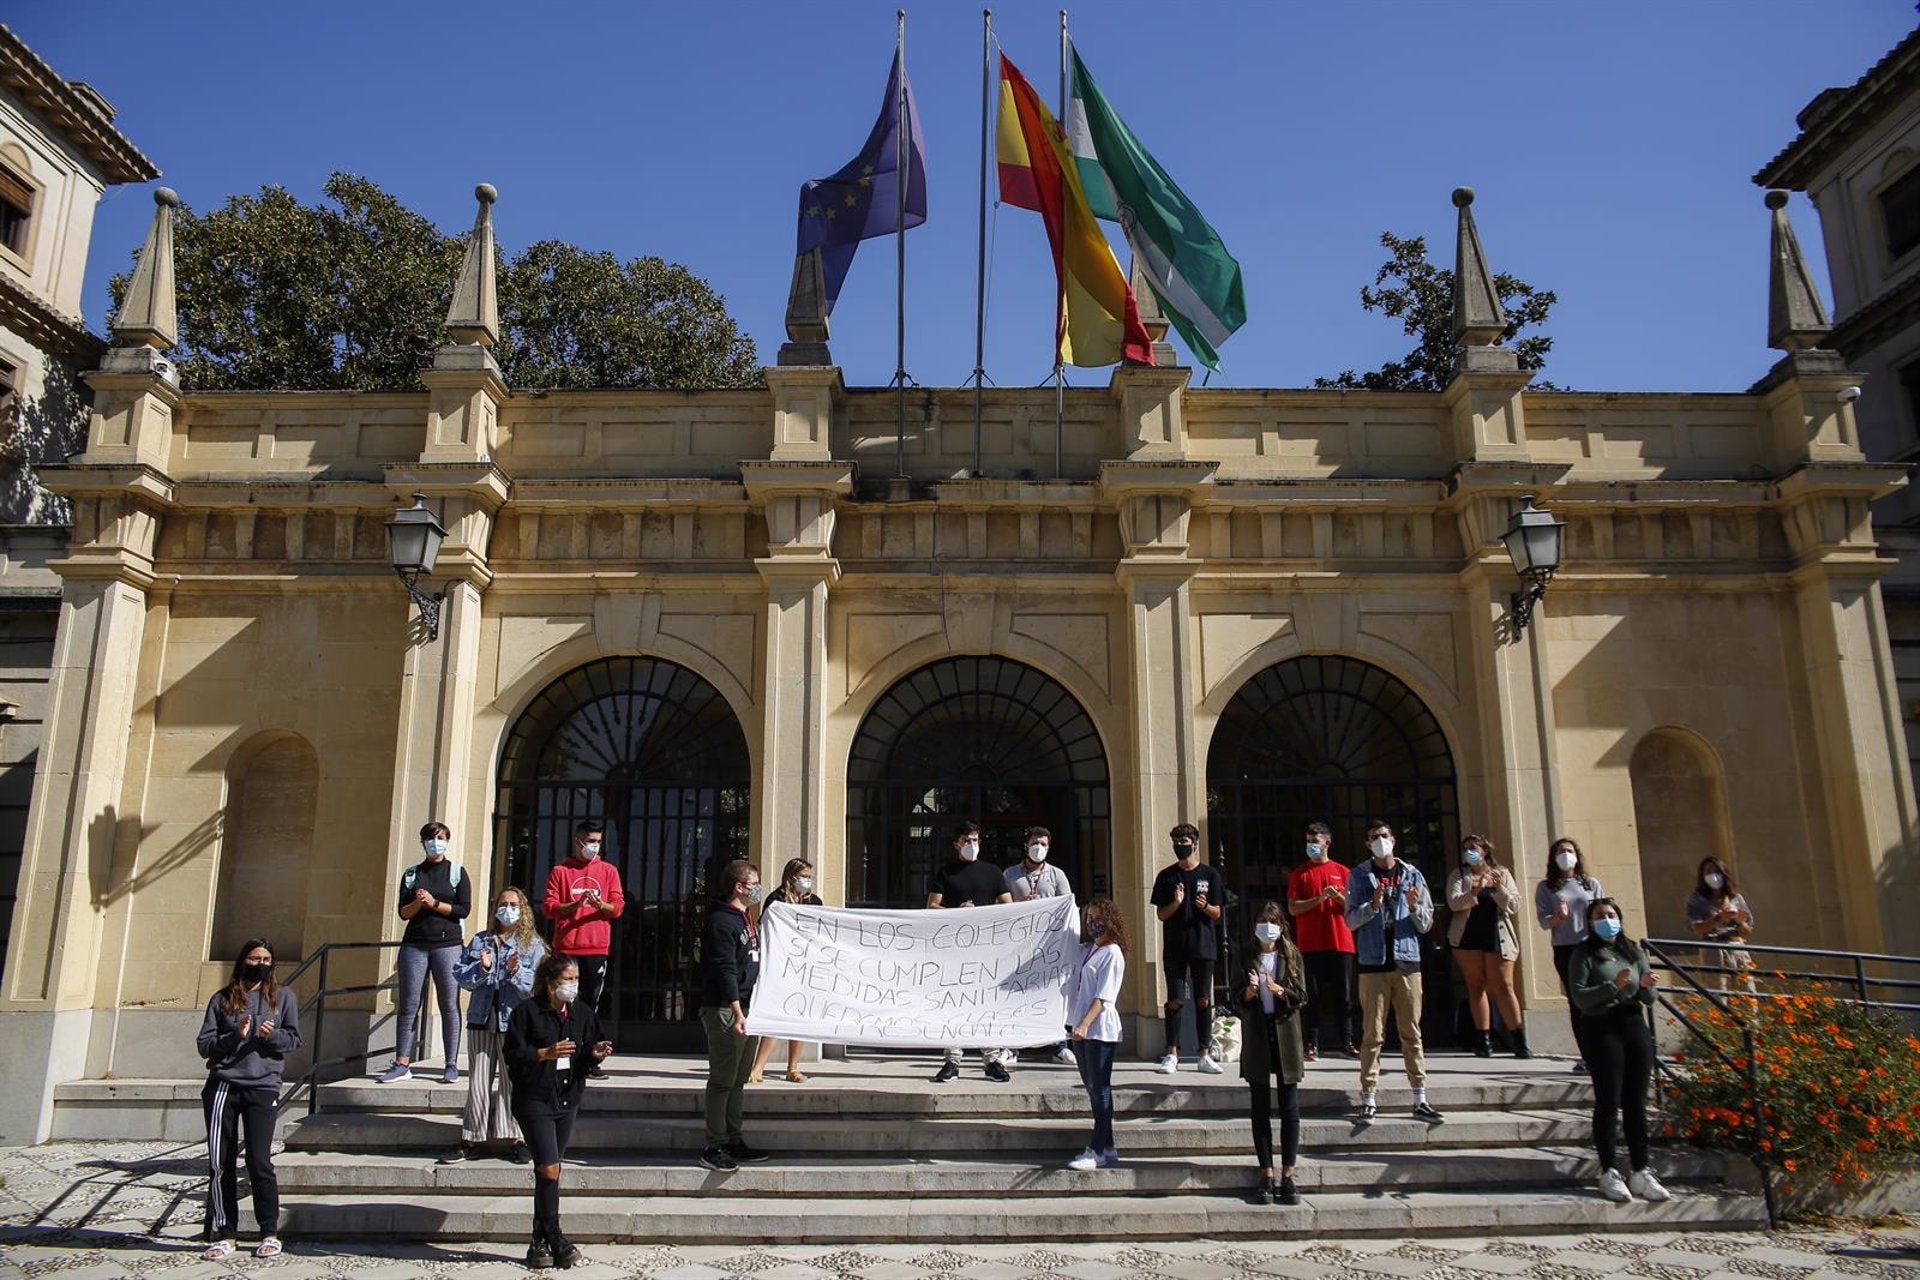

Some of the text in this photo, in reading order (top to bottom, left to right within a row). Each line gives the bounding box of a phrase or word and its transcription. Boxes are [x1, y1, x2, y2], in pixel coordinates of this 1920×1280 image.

[796, 911, 1065, 950] EN LOS COLEGIOS
[782, 957, 911, 1006] MEDIDAS
[817, 945, 847, 971] SE
[858, 957, 999, 987] CUMPLEN
[1015, 938, 1061, 975] LAS
